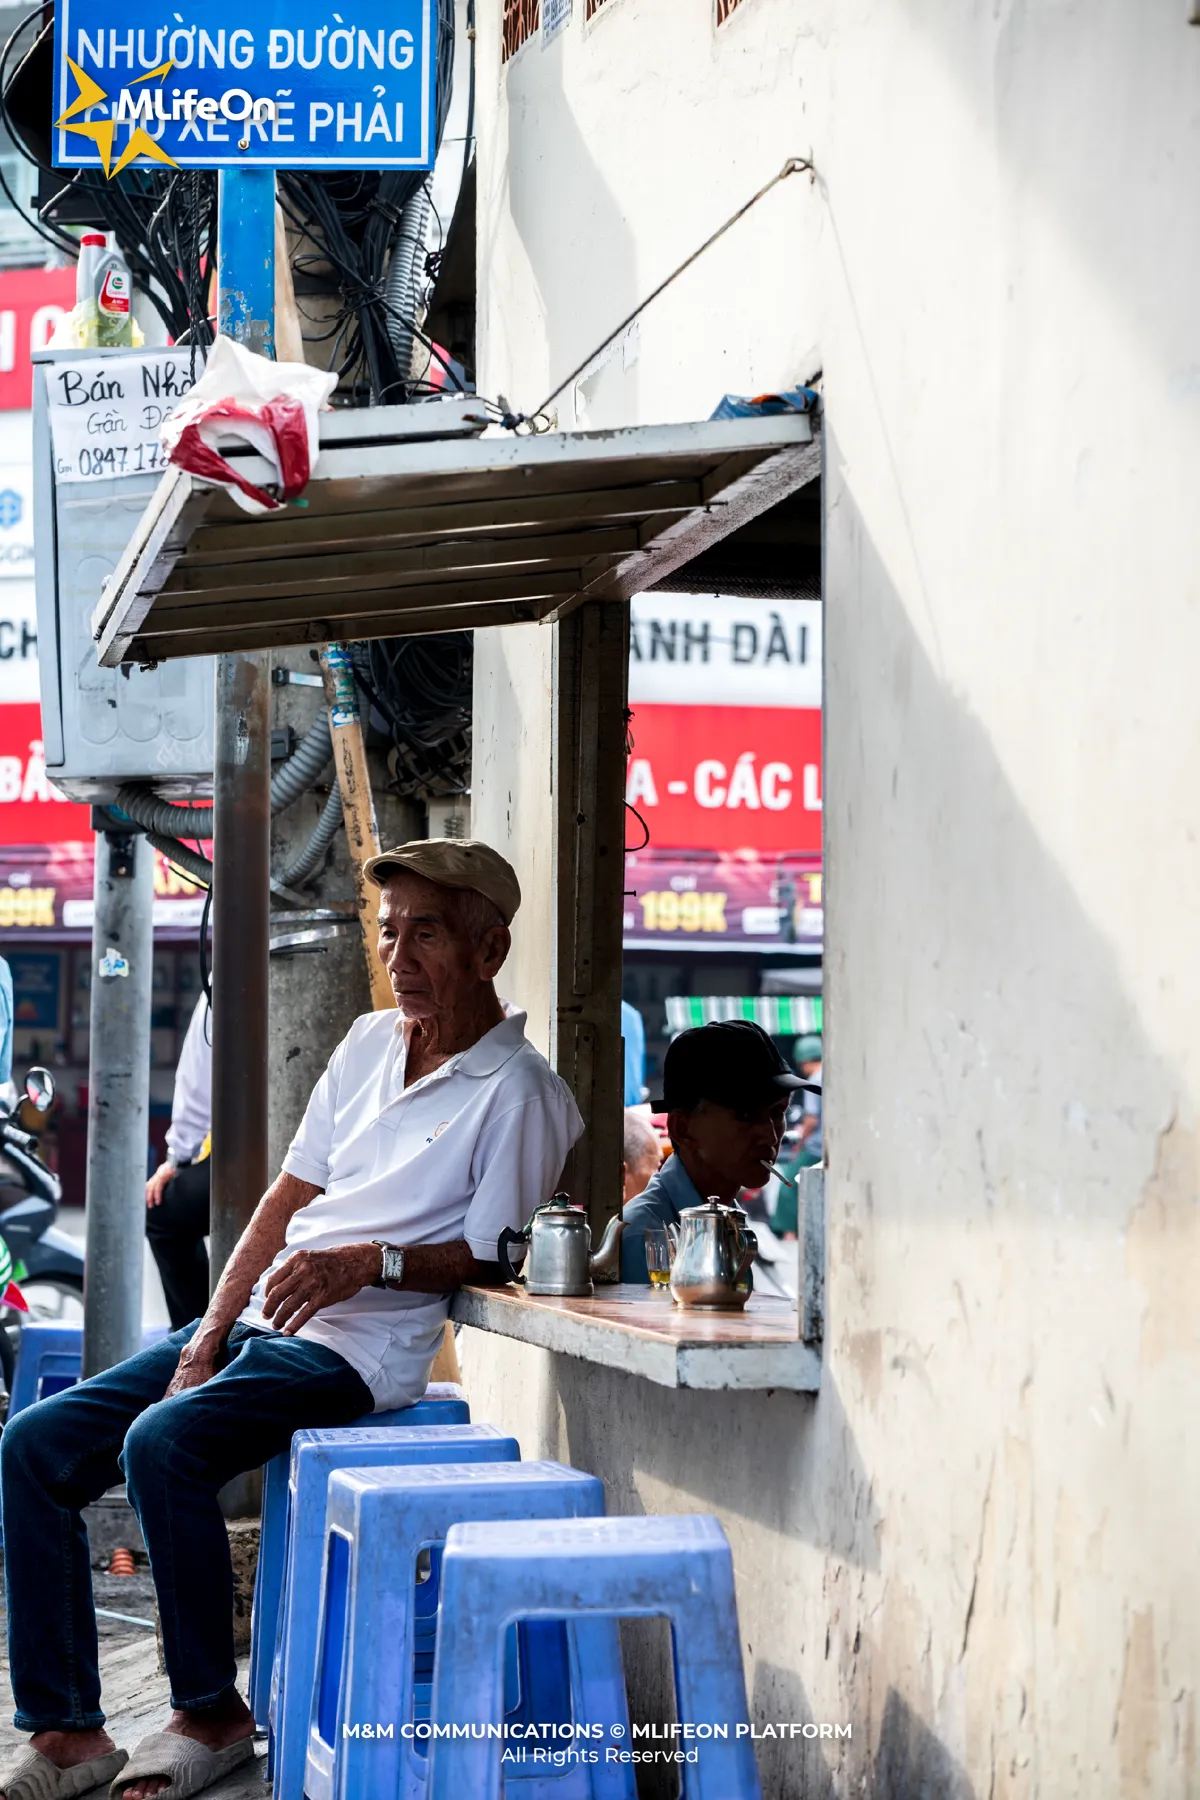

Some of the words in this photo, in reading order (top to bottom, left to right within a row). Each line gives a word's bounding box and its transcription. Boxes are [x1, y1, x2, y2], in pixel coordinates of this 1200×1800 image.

[78, 13, 254, 69] NHƯỜNG
[267, 13, 414, 69] ĐƯỜNG
[309, 84, 404, 142] PHẢI
[58, 370, 124, 406] Bán
[87, 409, 128, 434] Gần
[693, 751, 793, 811] CÁC
[638, 890, 728, 932] 199K
